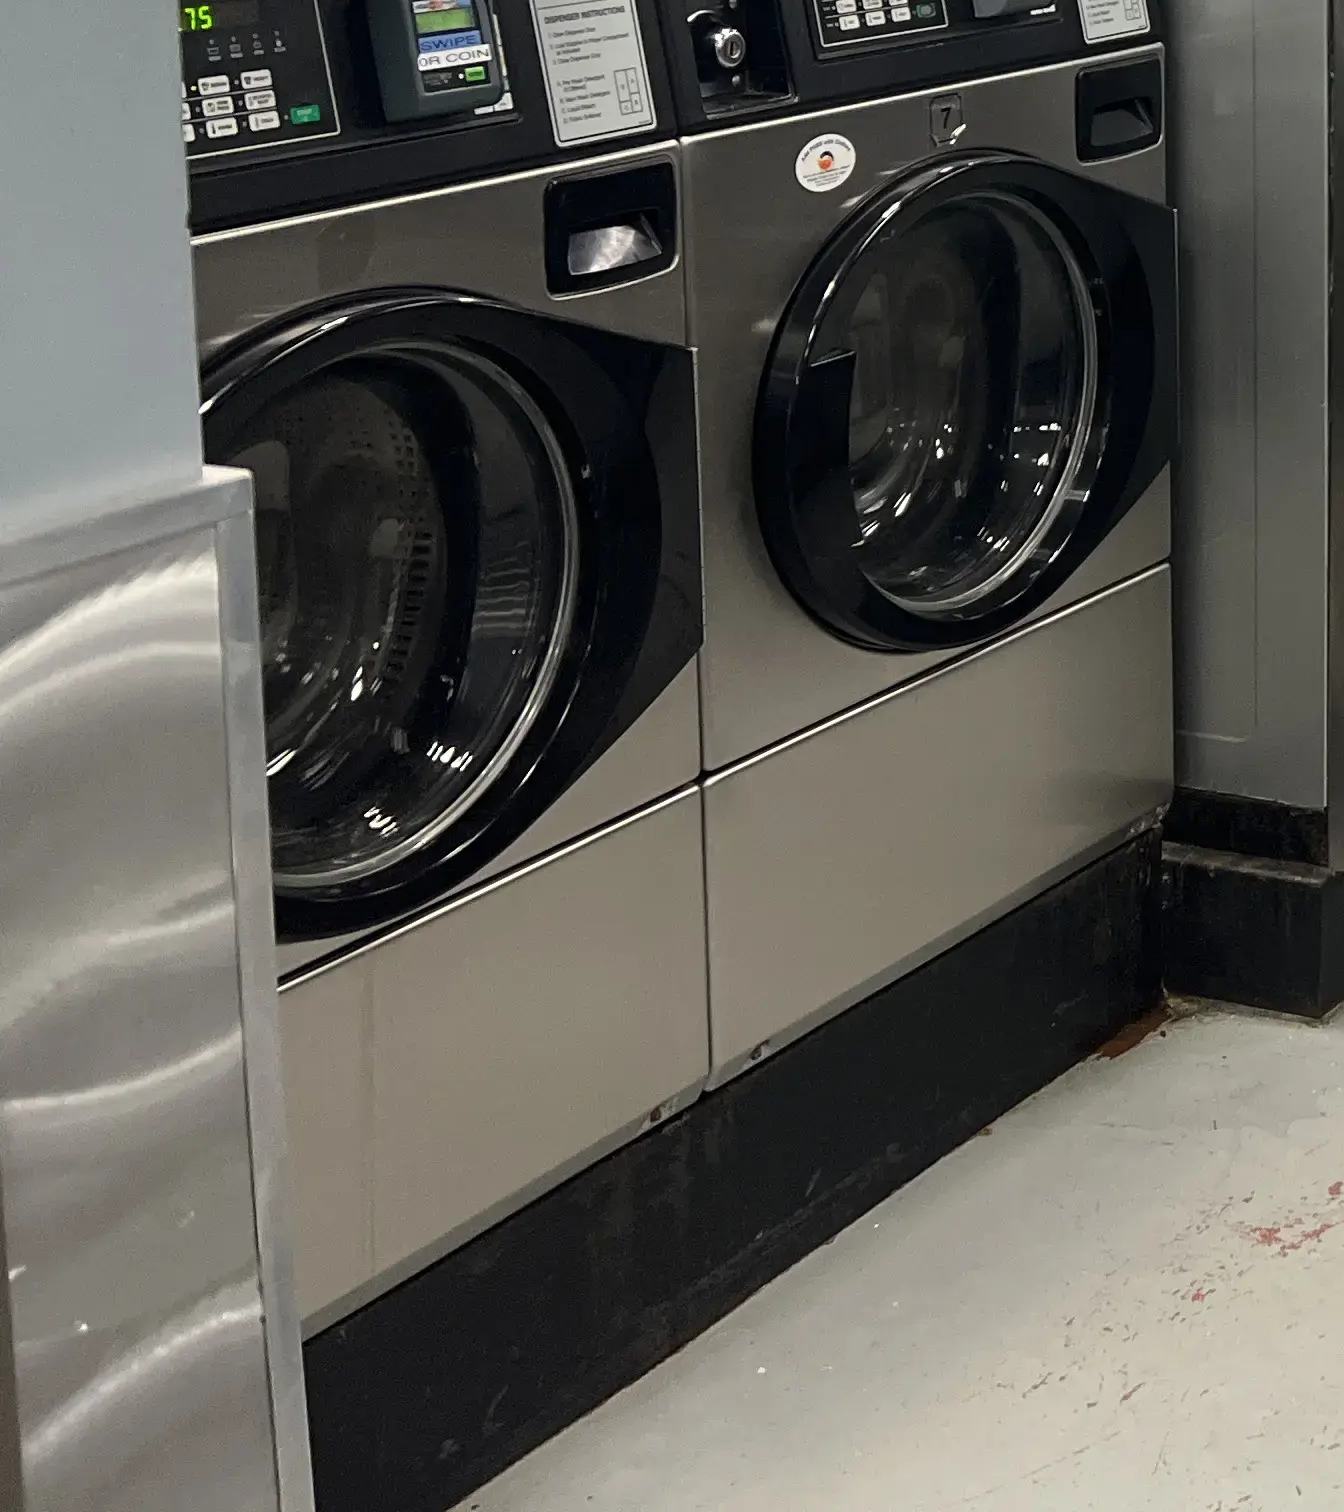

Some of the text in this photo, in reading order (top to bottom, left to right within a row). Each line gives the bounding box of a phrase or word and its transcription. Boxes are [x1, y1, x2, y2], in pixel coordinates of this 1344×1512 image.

[178, 5, 213, 30] 75
[420, 35, 477, 52] SWIPE
[418, 48, 490, 67] OR COIN
[940, 107, 952, 129] 7
